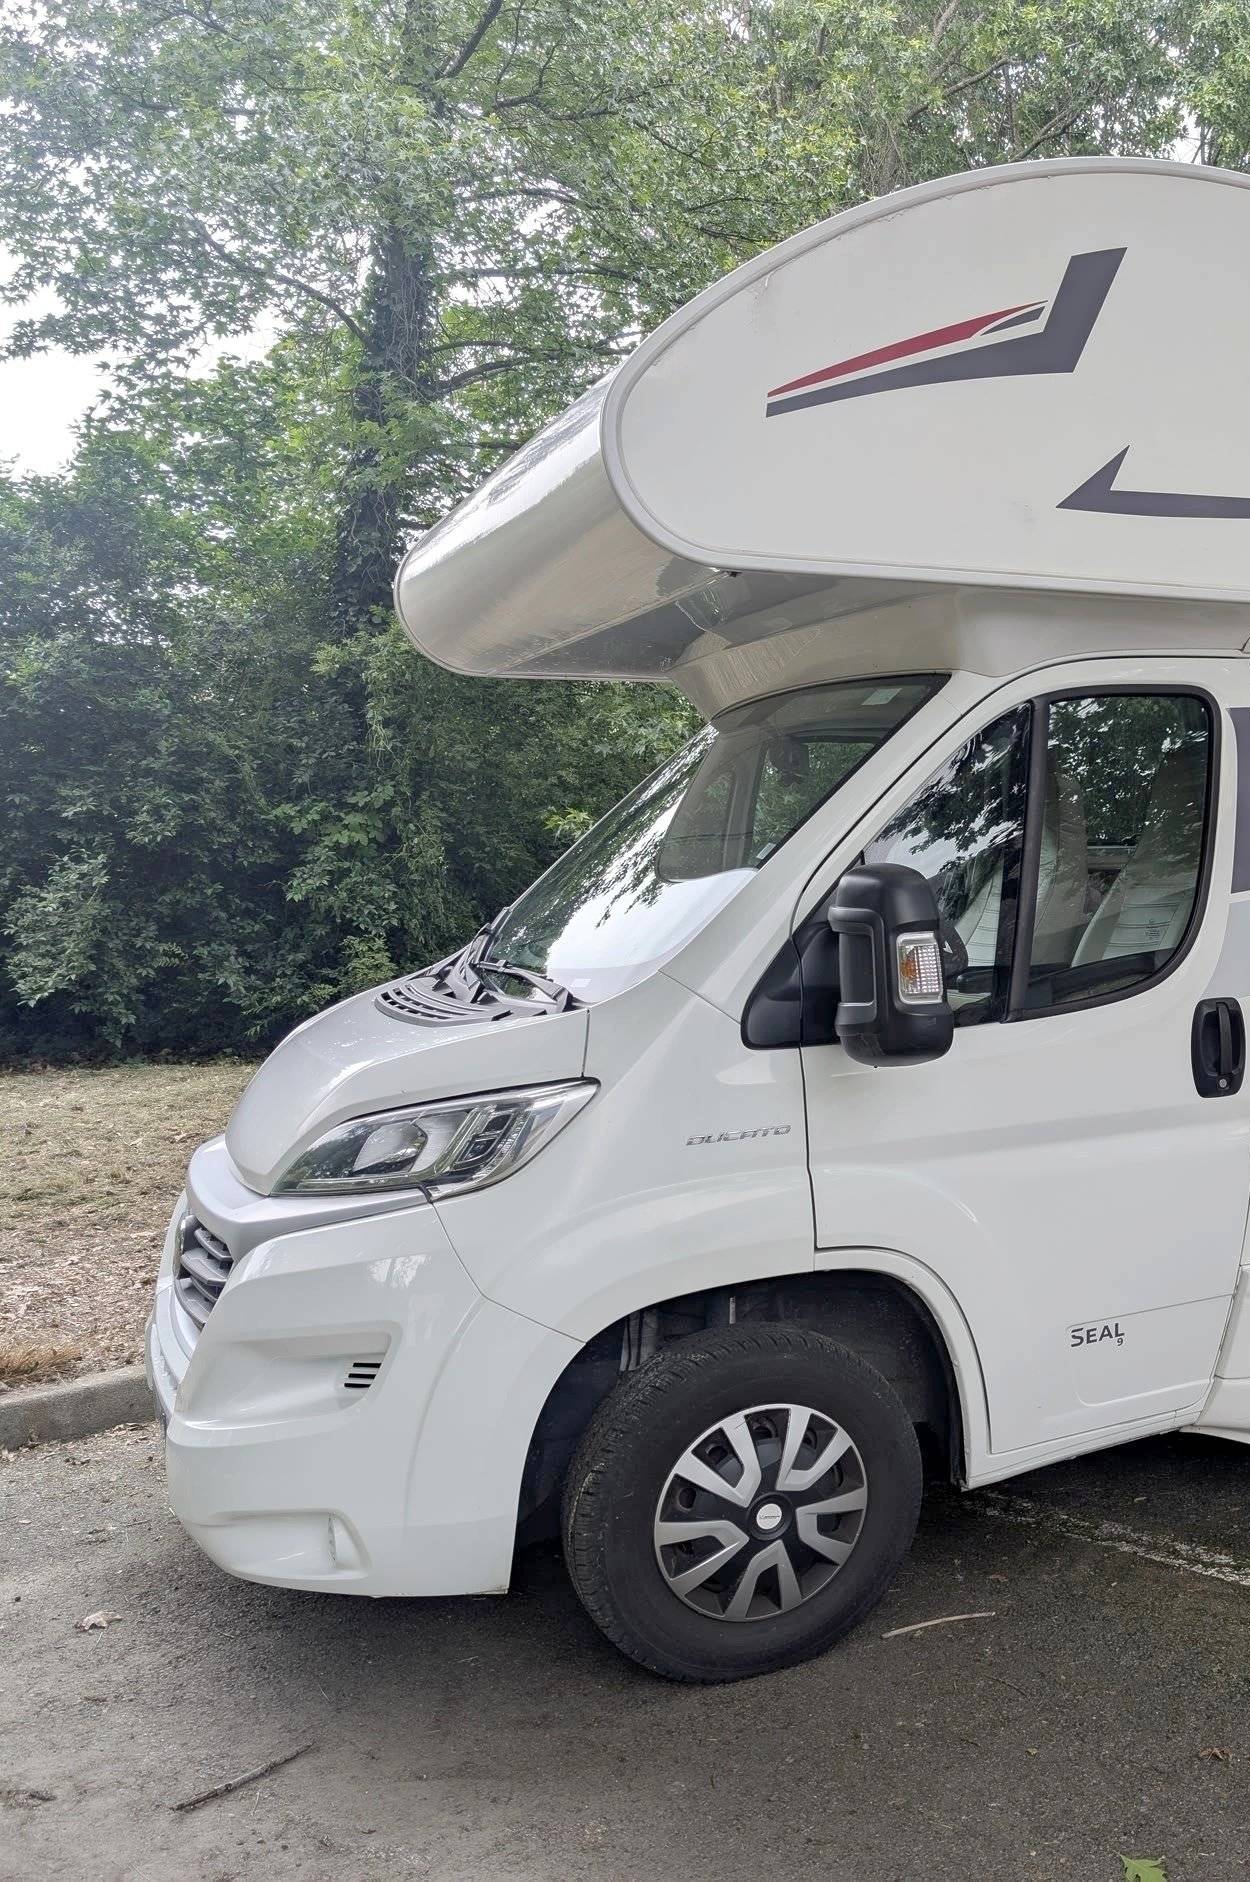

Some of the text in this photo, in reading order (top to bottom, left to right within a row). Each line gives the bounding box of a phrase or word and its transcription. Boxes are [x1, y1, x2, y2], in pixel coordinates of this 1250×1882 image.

[686, 1125, 792, 1146] DUCATO
[1070, 1323, 1125, 1348] SEAL
[1117, 1338, 1124, 1347] 9
